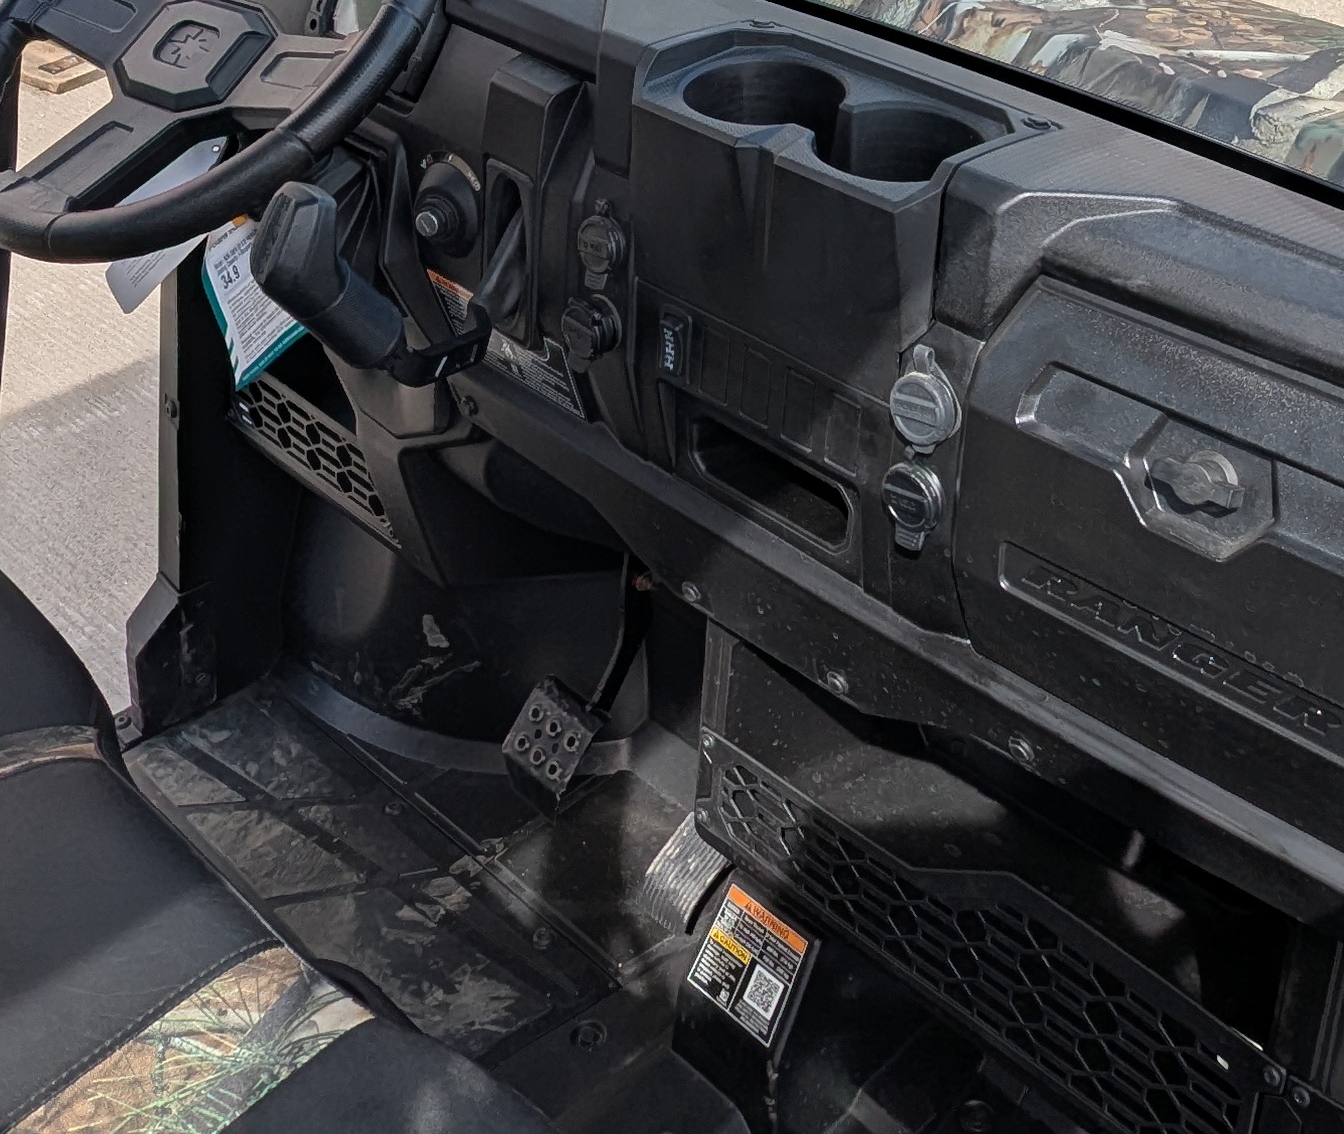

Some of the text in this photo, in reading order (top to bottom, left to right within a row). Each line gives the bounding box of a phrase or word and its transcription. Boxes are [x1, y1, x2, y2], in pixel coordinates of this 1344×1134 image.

[219, 264, 241, 290] 34.9
[1019, 567, 1344, 737] RANGER
[718, 933, 747, 962] CAUTION
